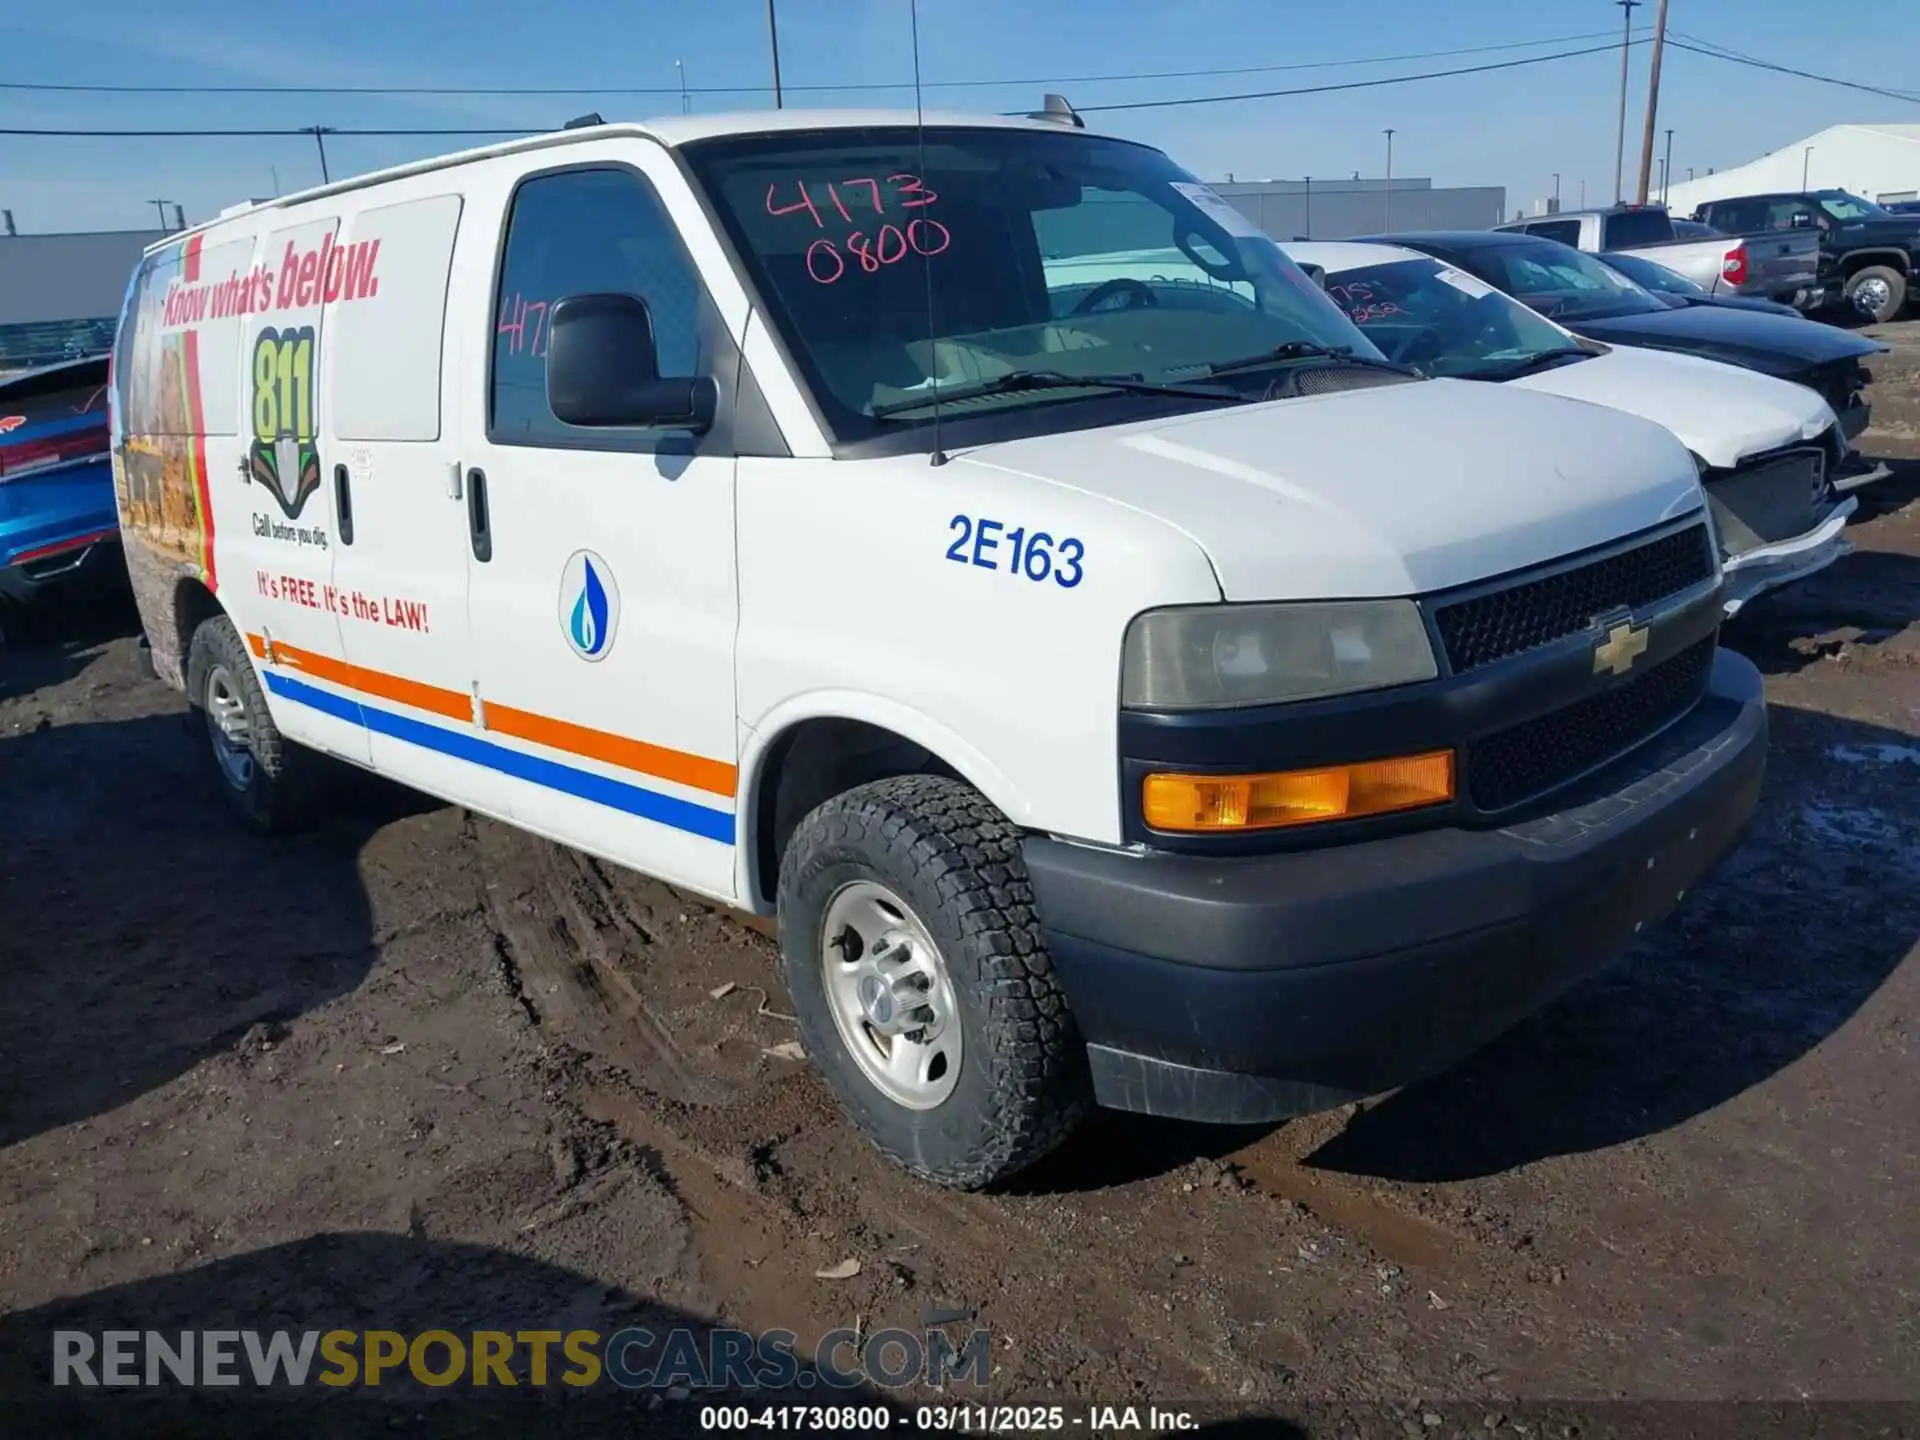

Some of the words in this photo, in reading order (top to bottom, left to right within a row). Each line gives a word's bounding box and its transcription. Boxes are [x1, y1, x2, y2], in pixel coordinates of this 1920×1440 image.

[766, 174, 938, 229] 4173
[163, 283, 210, 327] Know
[210, 264, 274, 318] what's
[276, 232, 381, 310] below.
[806, 218, 951, 284] 0800
[498, 291, 549, 357] 417
[253, 338, 310, 444] 811
[252, 512, 271, 538] Call
[271, 520, 296, 542] before
[296, 527, 312, 546] you
[946, 514, 1085, 588] 2E163
[256, 569, 279, 599] It's
[280, 575, 321, 609] FREE.
[323, 584, 349, 616] It's
[351, 591, 380, 623] the
[383, 597, 430, 633] LAW!
